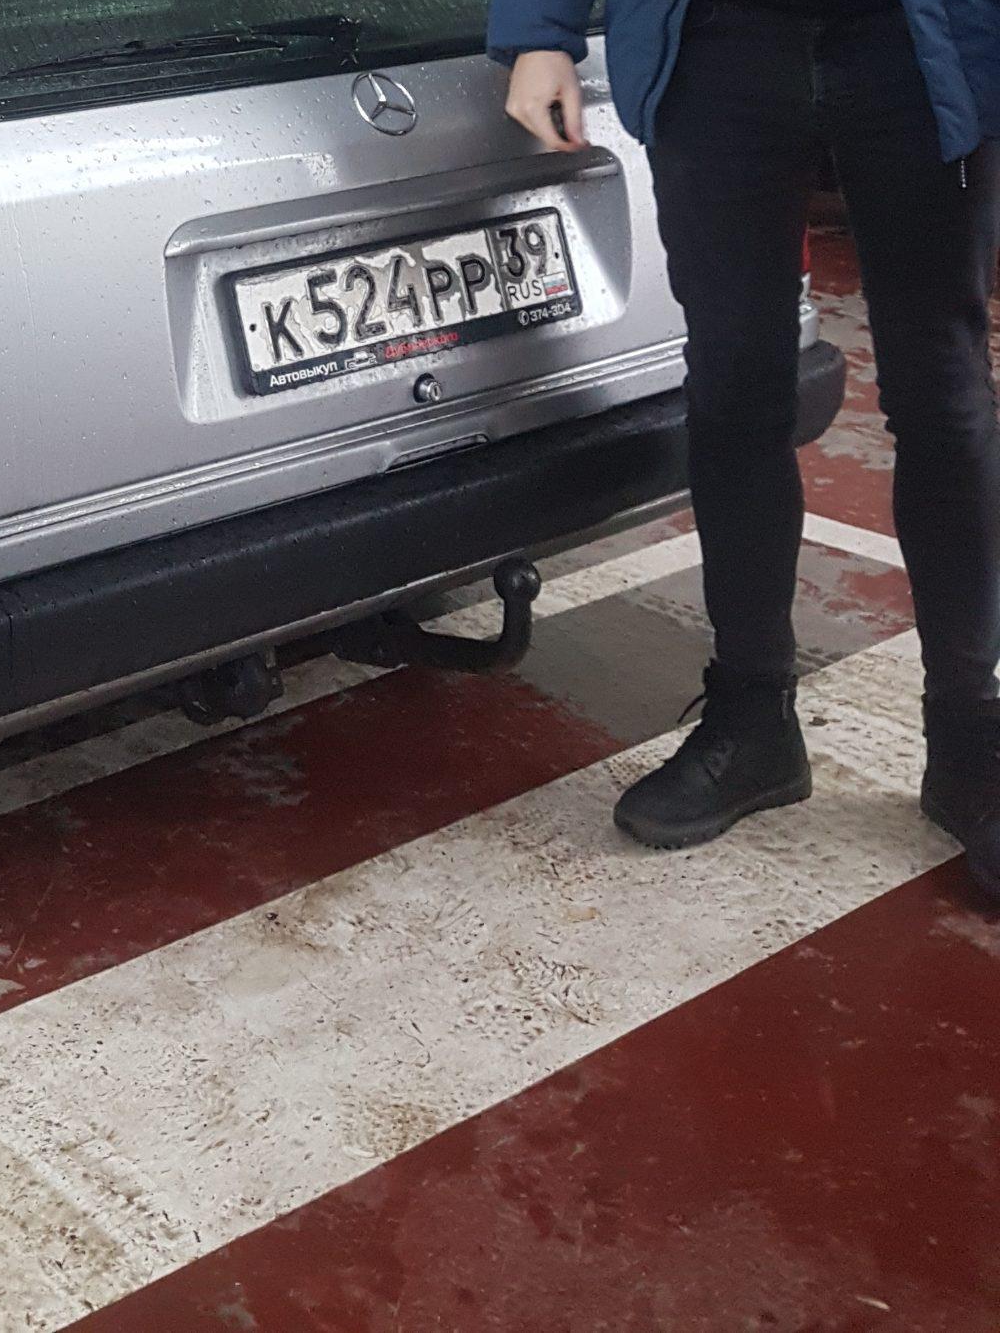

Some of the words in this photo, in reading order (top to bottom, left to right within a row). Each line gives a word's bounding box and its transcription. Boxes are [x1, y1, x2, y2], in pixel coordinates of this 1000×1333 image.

[496, 221, 548, 281] 39
[508, 276, 542, 302] RUS
[269, 361, 338, 388] Автовыкуп
